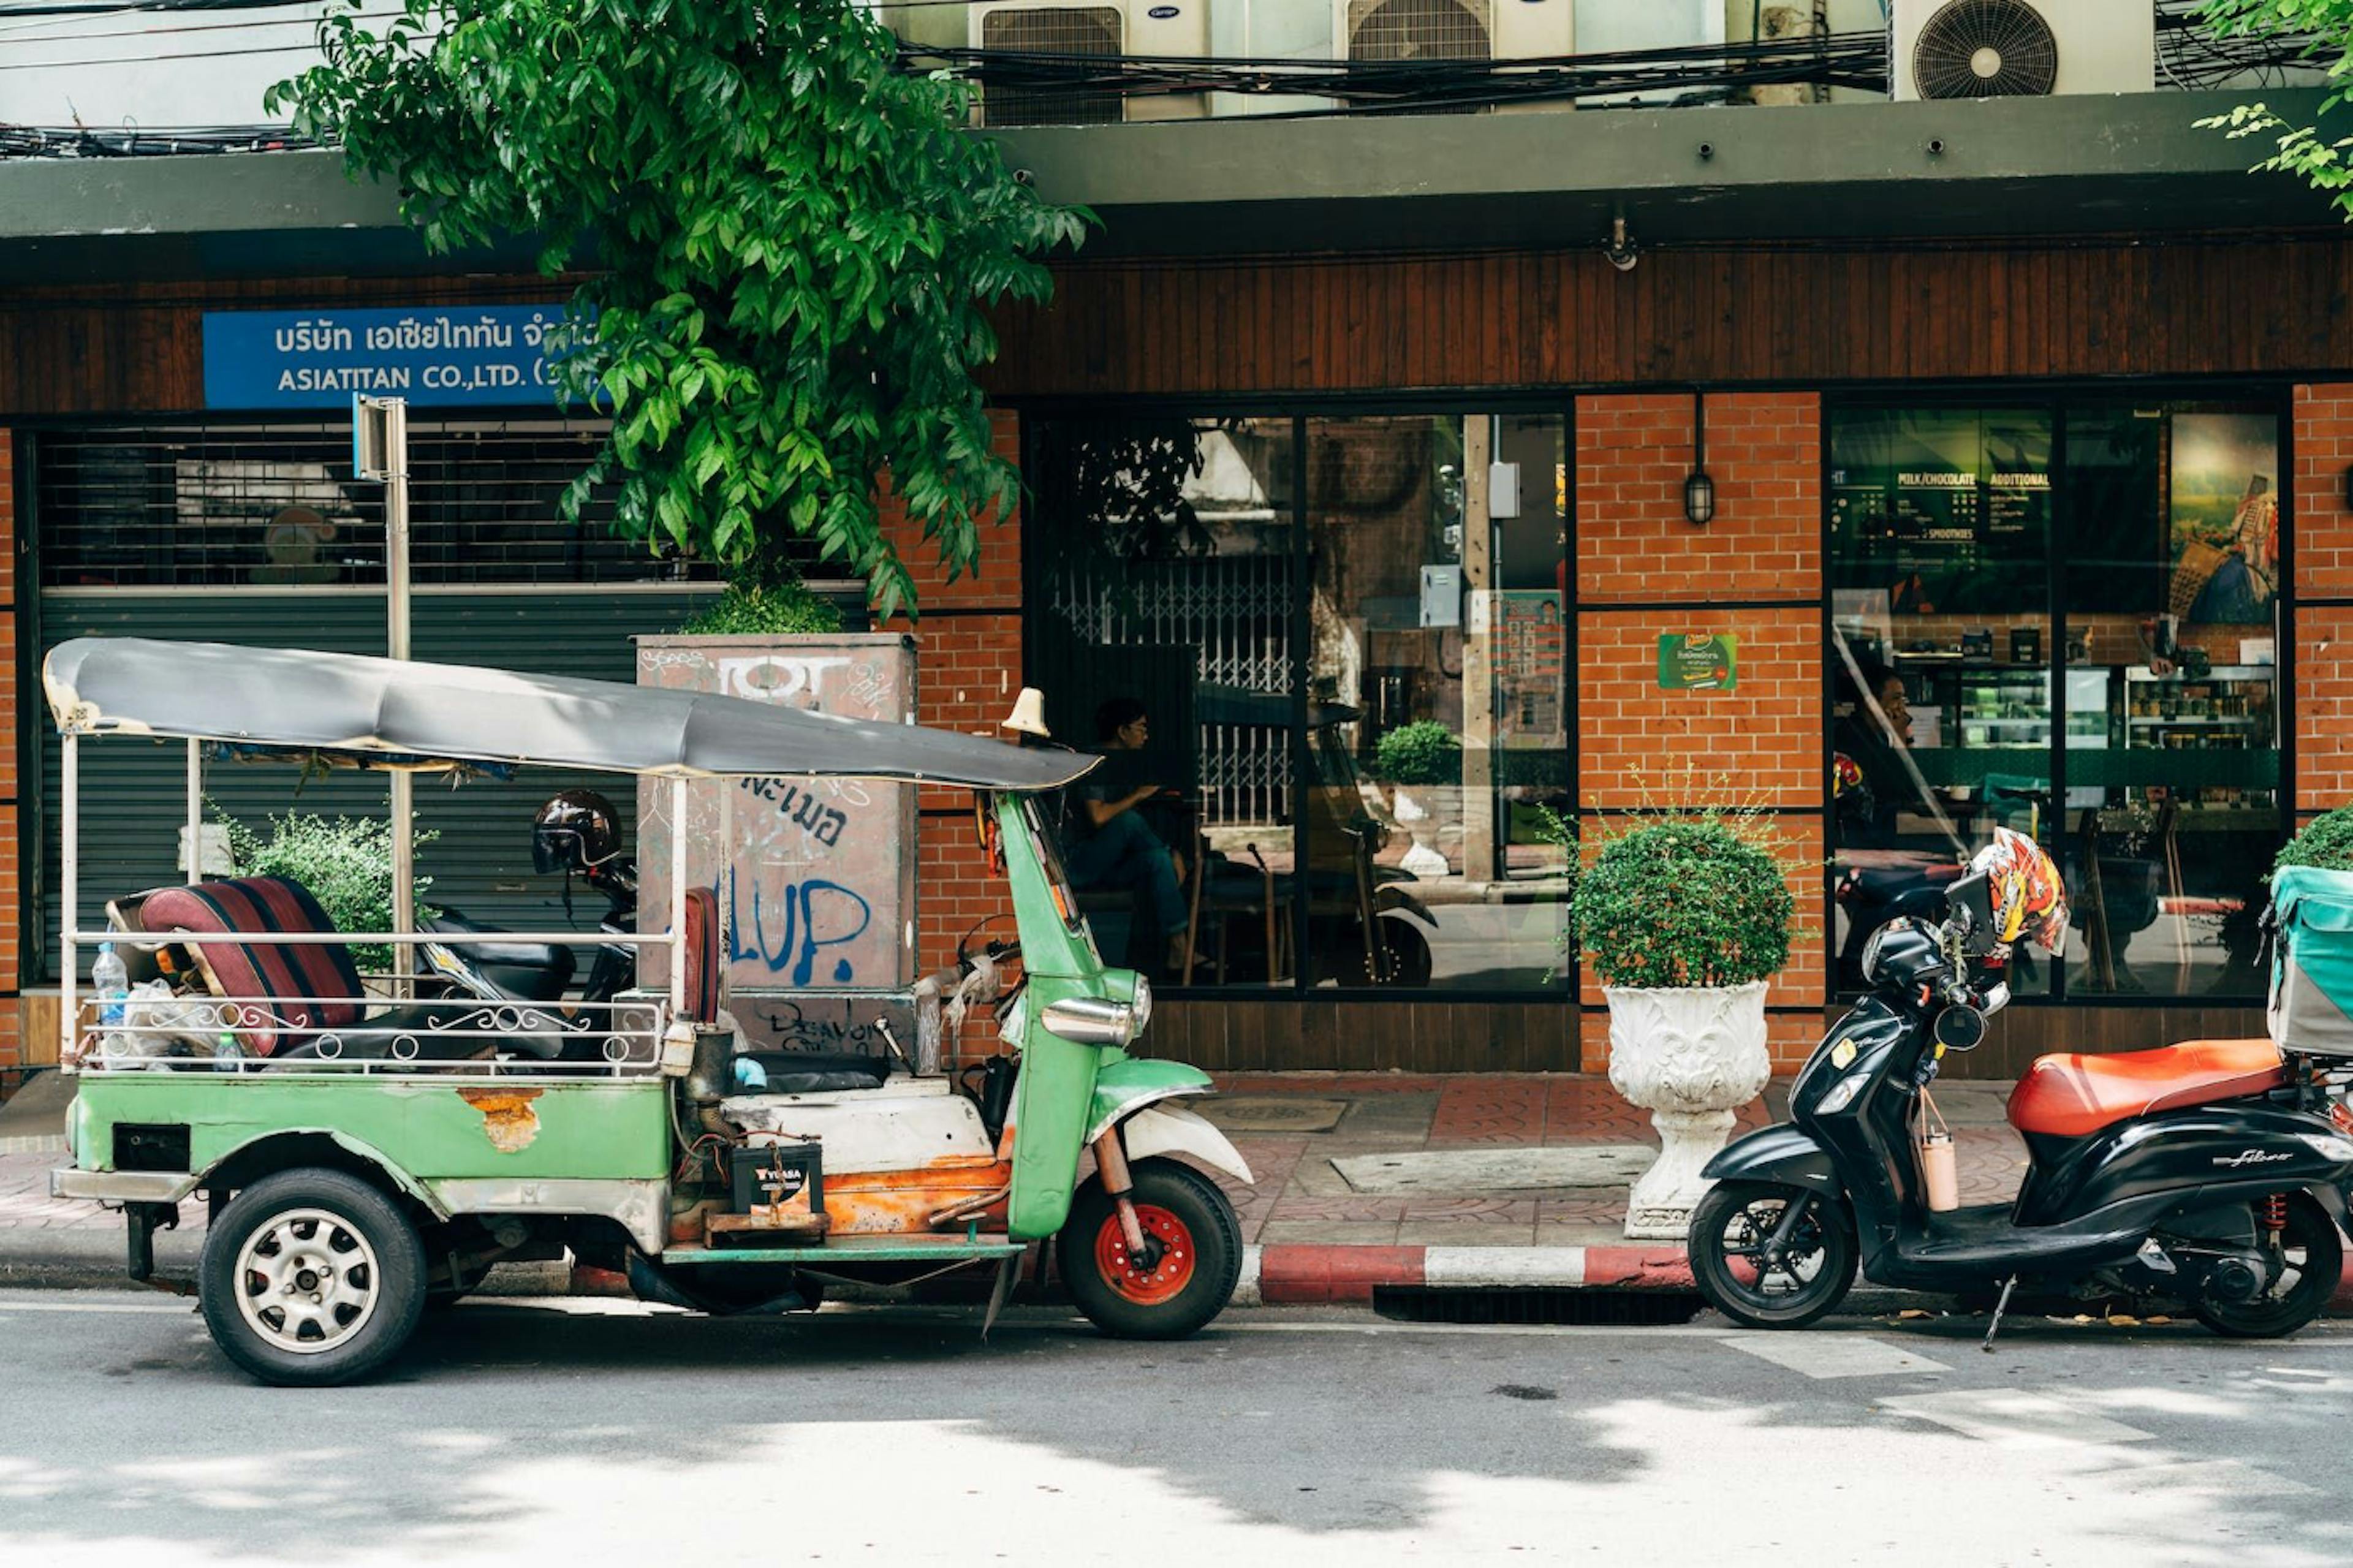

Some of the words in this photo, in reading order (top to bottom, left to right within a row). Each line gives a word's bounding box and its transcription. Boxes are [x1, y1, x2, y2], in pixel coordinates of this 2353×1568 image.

[276, 318, 353, 352] บริษัท
[366, 315, 512, 350] เอเชียไททัน
[278, 367, 411, 391] ASIATITAN
[422, 365, 527, 391] CO.,LTD.
[1898, 472, 1976, 486] MILK/CHOCOLATE
[1990, 473, 2050, 486] ADDITIONAL
